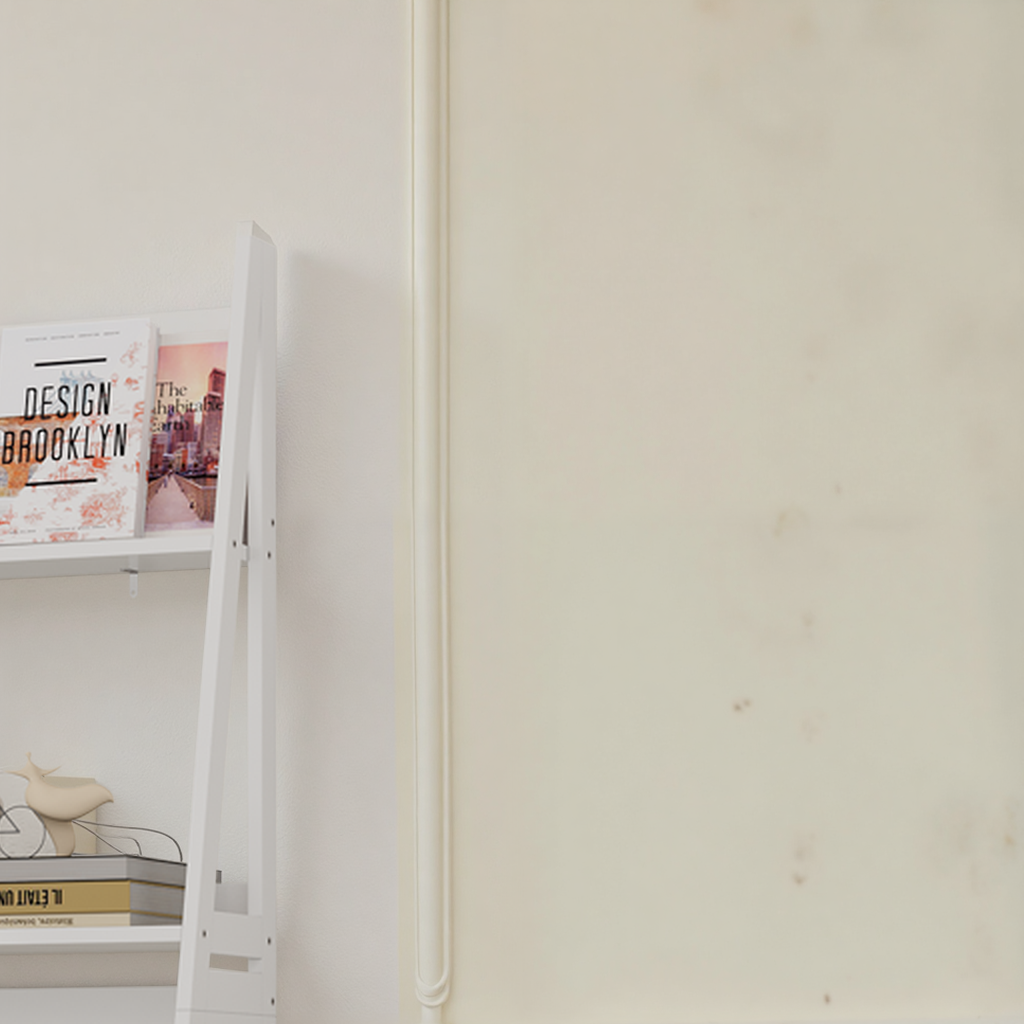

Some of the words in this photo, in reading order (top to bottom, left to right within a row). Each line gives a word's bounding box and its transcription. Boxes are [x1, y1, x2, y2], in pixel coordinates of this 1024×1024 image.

[156, 381, 188, 398] The
[24, 381, 112, 421] DESIGN
[1, 423, 127, 465] BROOKLYN
[16, 889, 49, 908] ÉTAIT
[51, 889, 63, 906] IL
